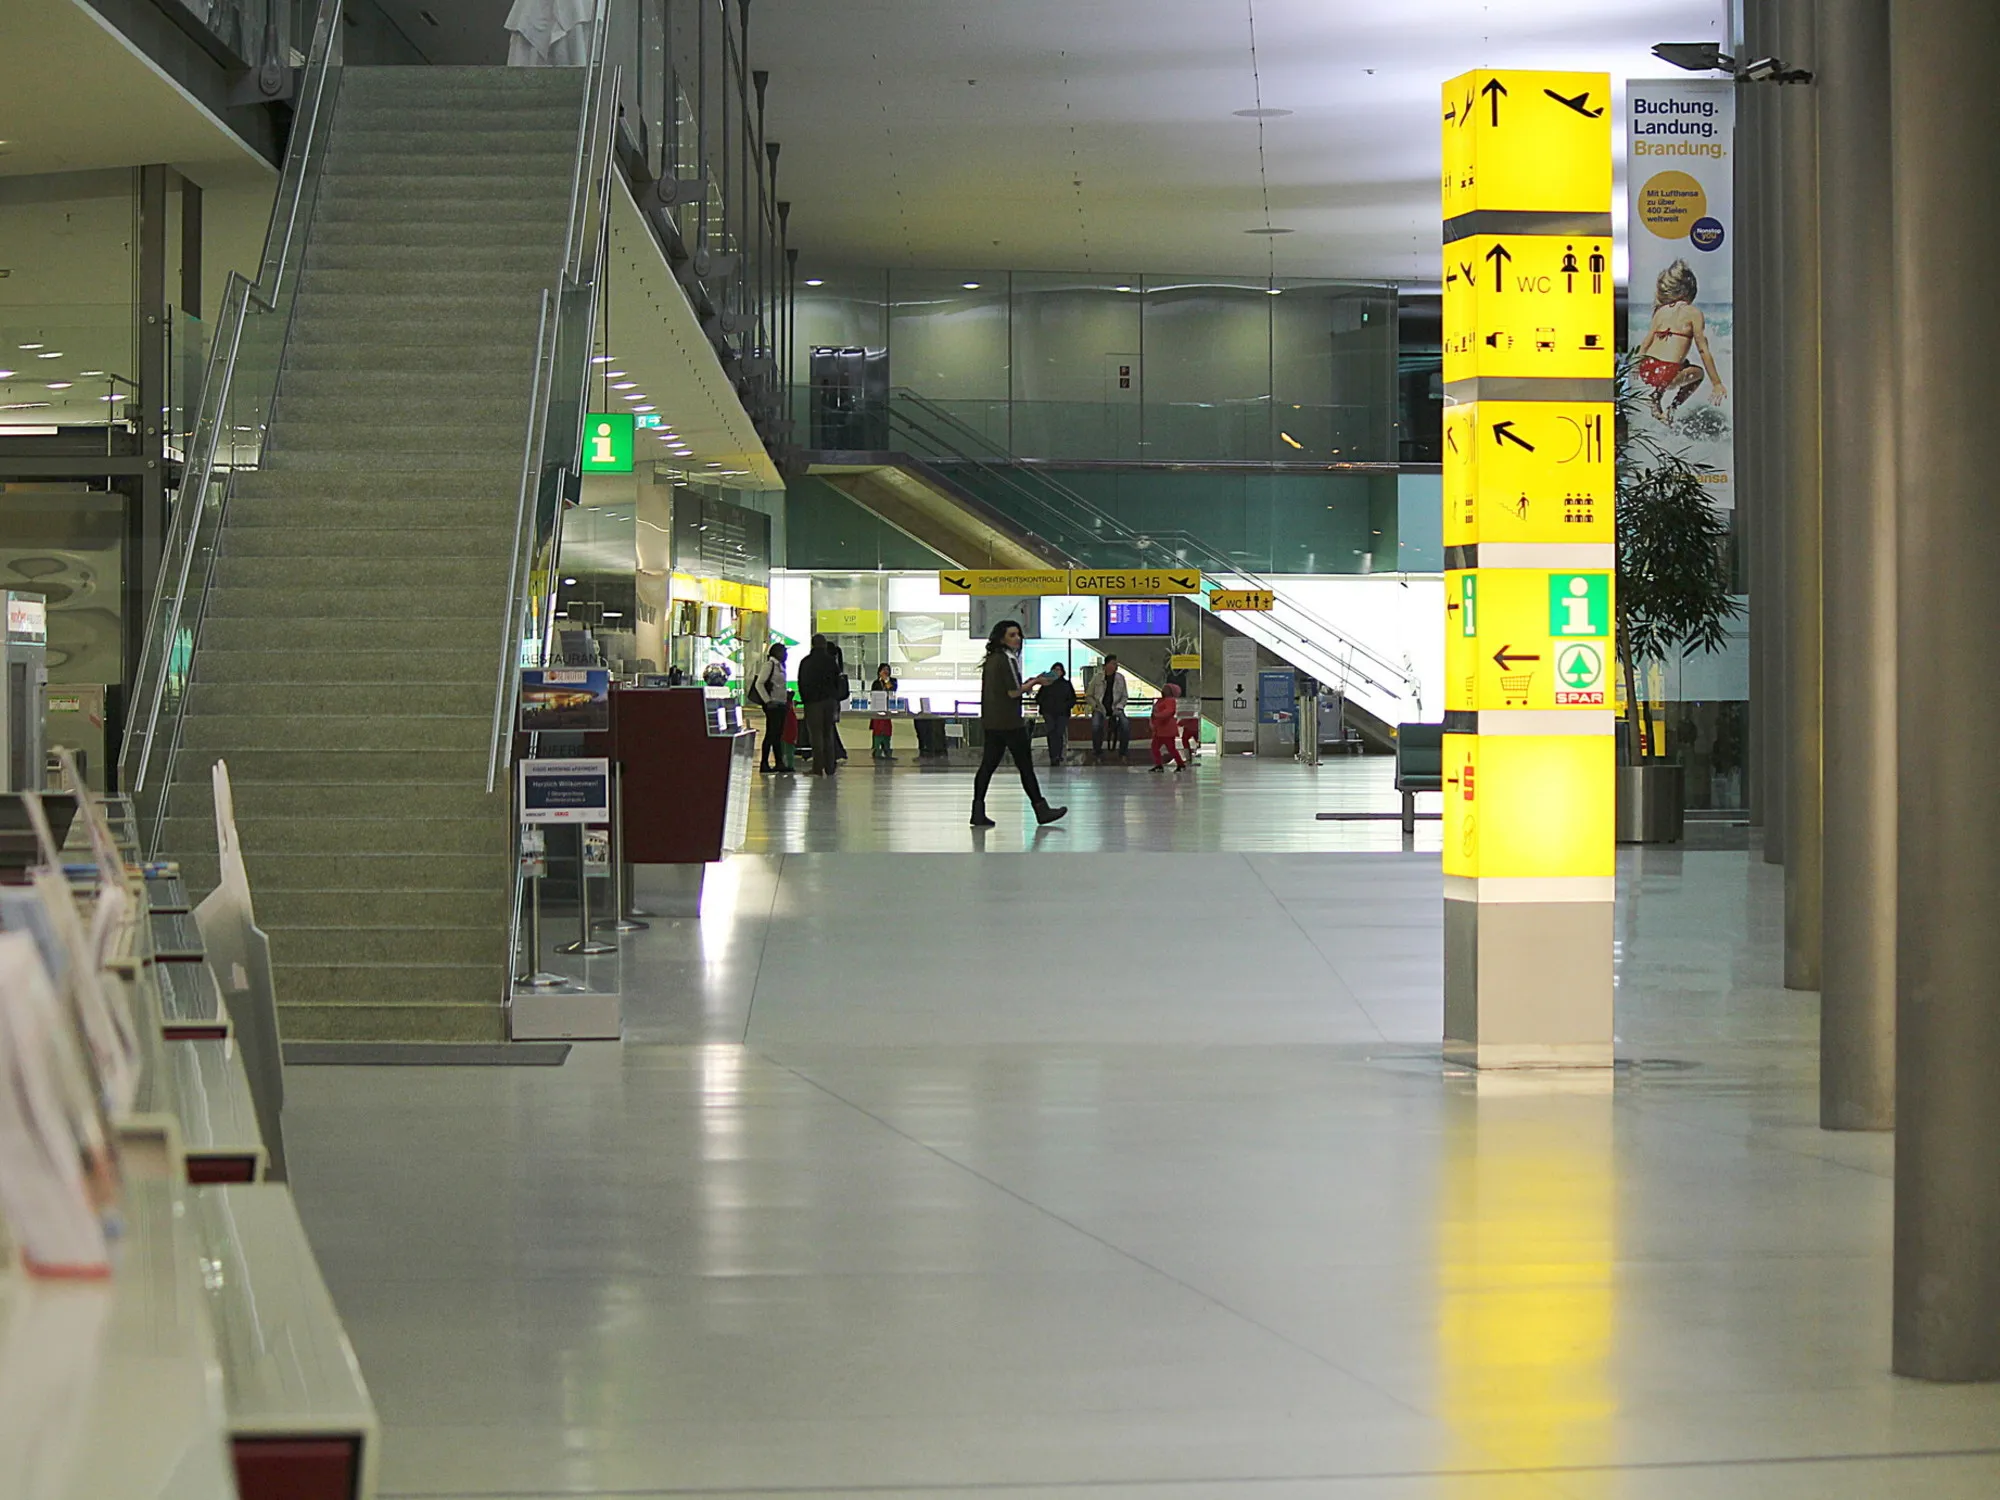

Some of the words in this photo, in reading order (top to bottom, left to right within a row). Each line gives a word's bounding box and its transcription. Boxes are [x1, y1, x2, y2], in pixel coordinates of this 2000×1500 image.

[1634, 98, 1719, 117] Buchung.
[1634, 119, 1718, 137] Landung.
[1634, 140, 1727, 159] Brandung.
[1516, 276, 1552, 294] WC
[978, 575, 1064, 584] SICHERHEITSKONTROLLE
[1075, 575, 1126, 589] GATES
[1131, 575, 1161, 589] 1-15
[1226, 599, 1242, 609] WC
[1556, 692, 1603, 704] SPAR
